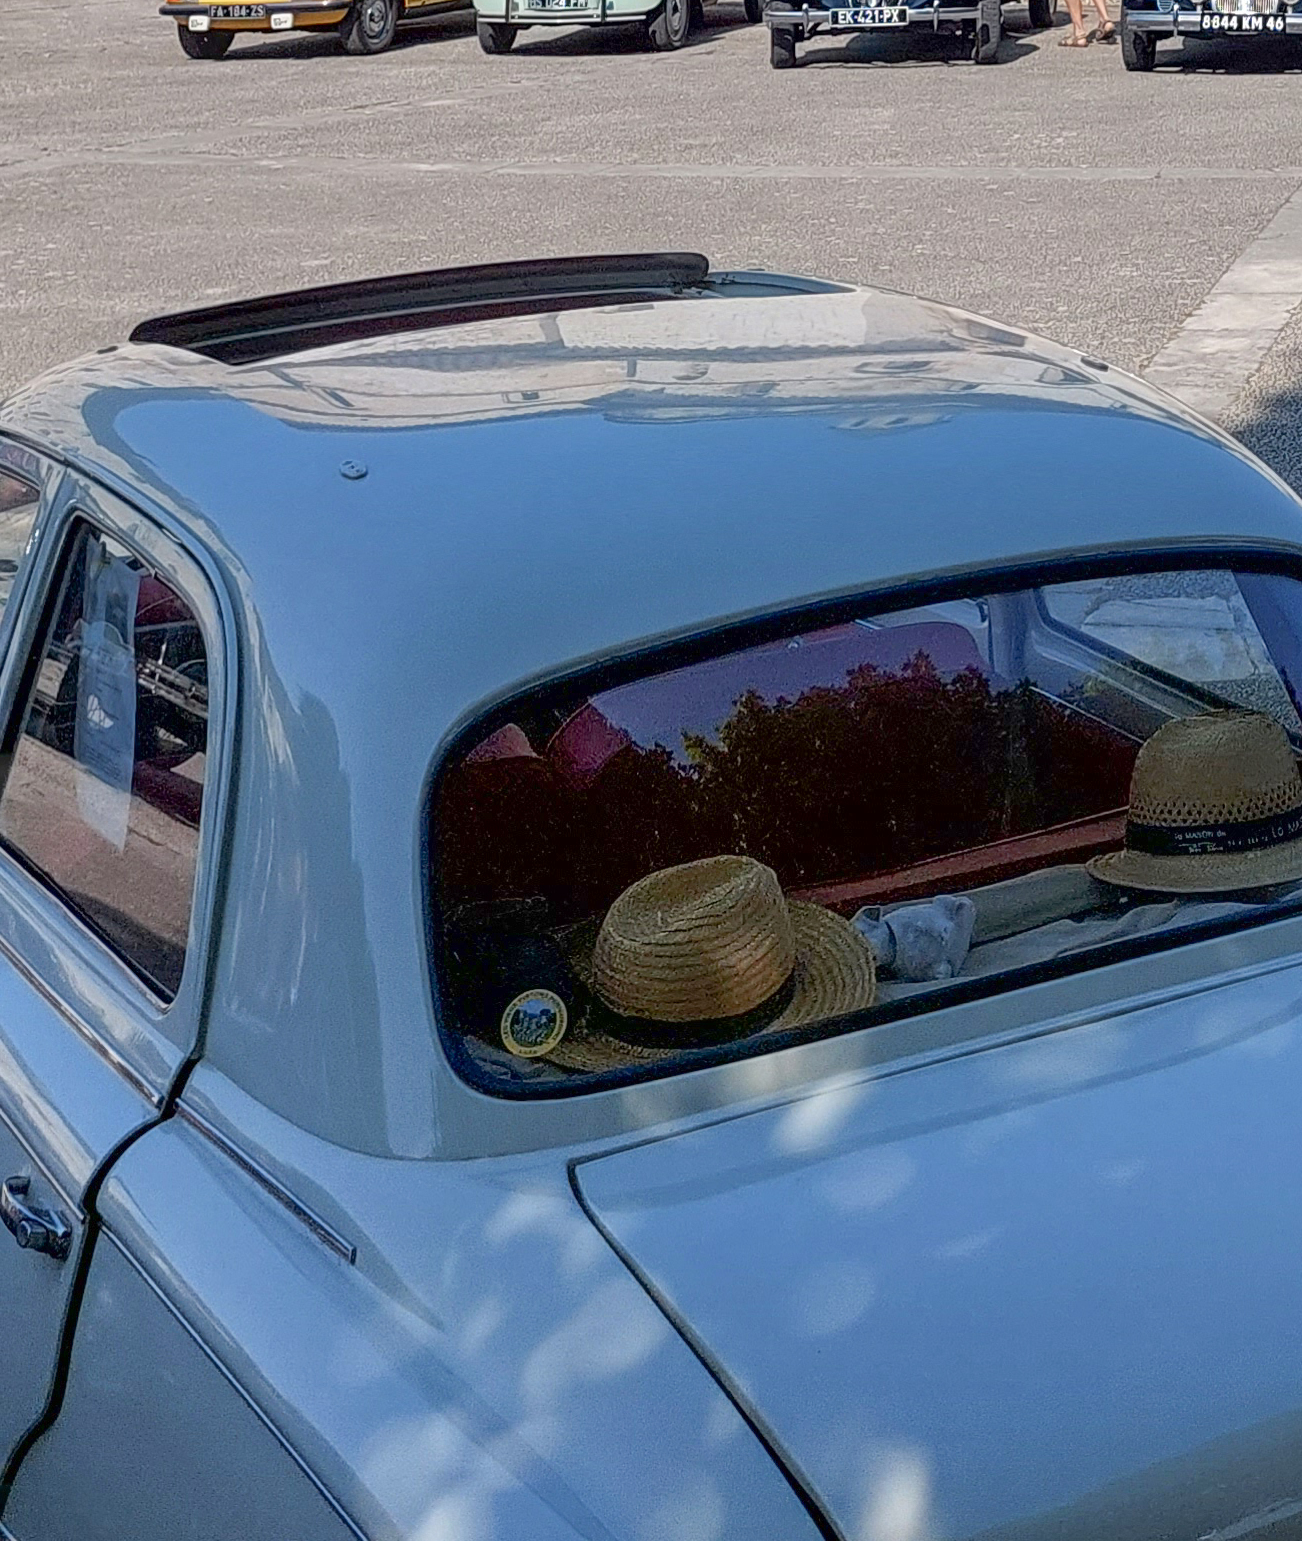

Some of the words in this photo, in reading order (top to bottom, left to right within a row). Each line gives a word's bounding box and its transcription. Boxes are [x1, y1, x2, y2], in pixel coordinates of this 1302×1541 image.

[1202, 15, 1238, 30] 8844
[1242, 15, 1263, 31] KM
[1266, 16, 1284, 31] 46
